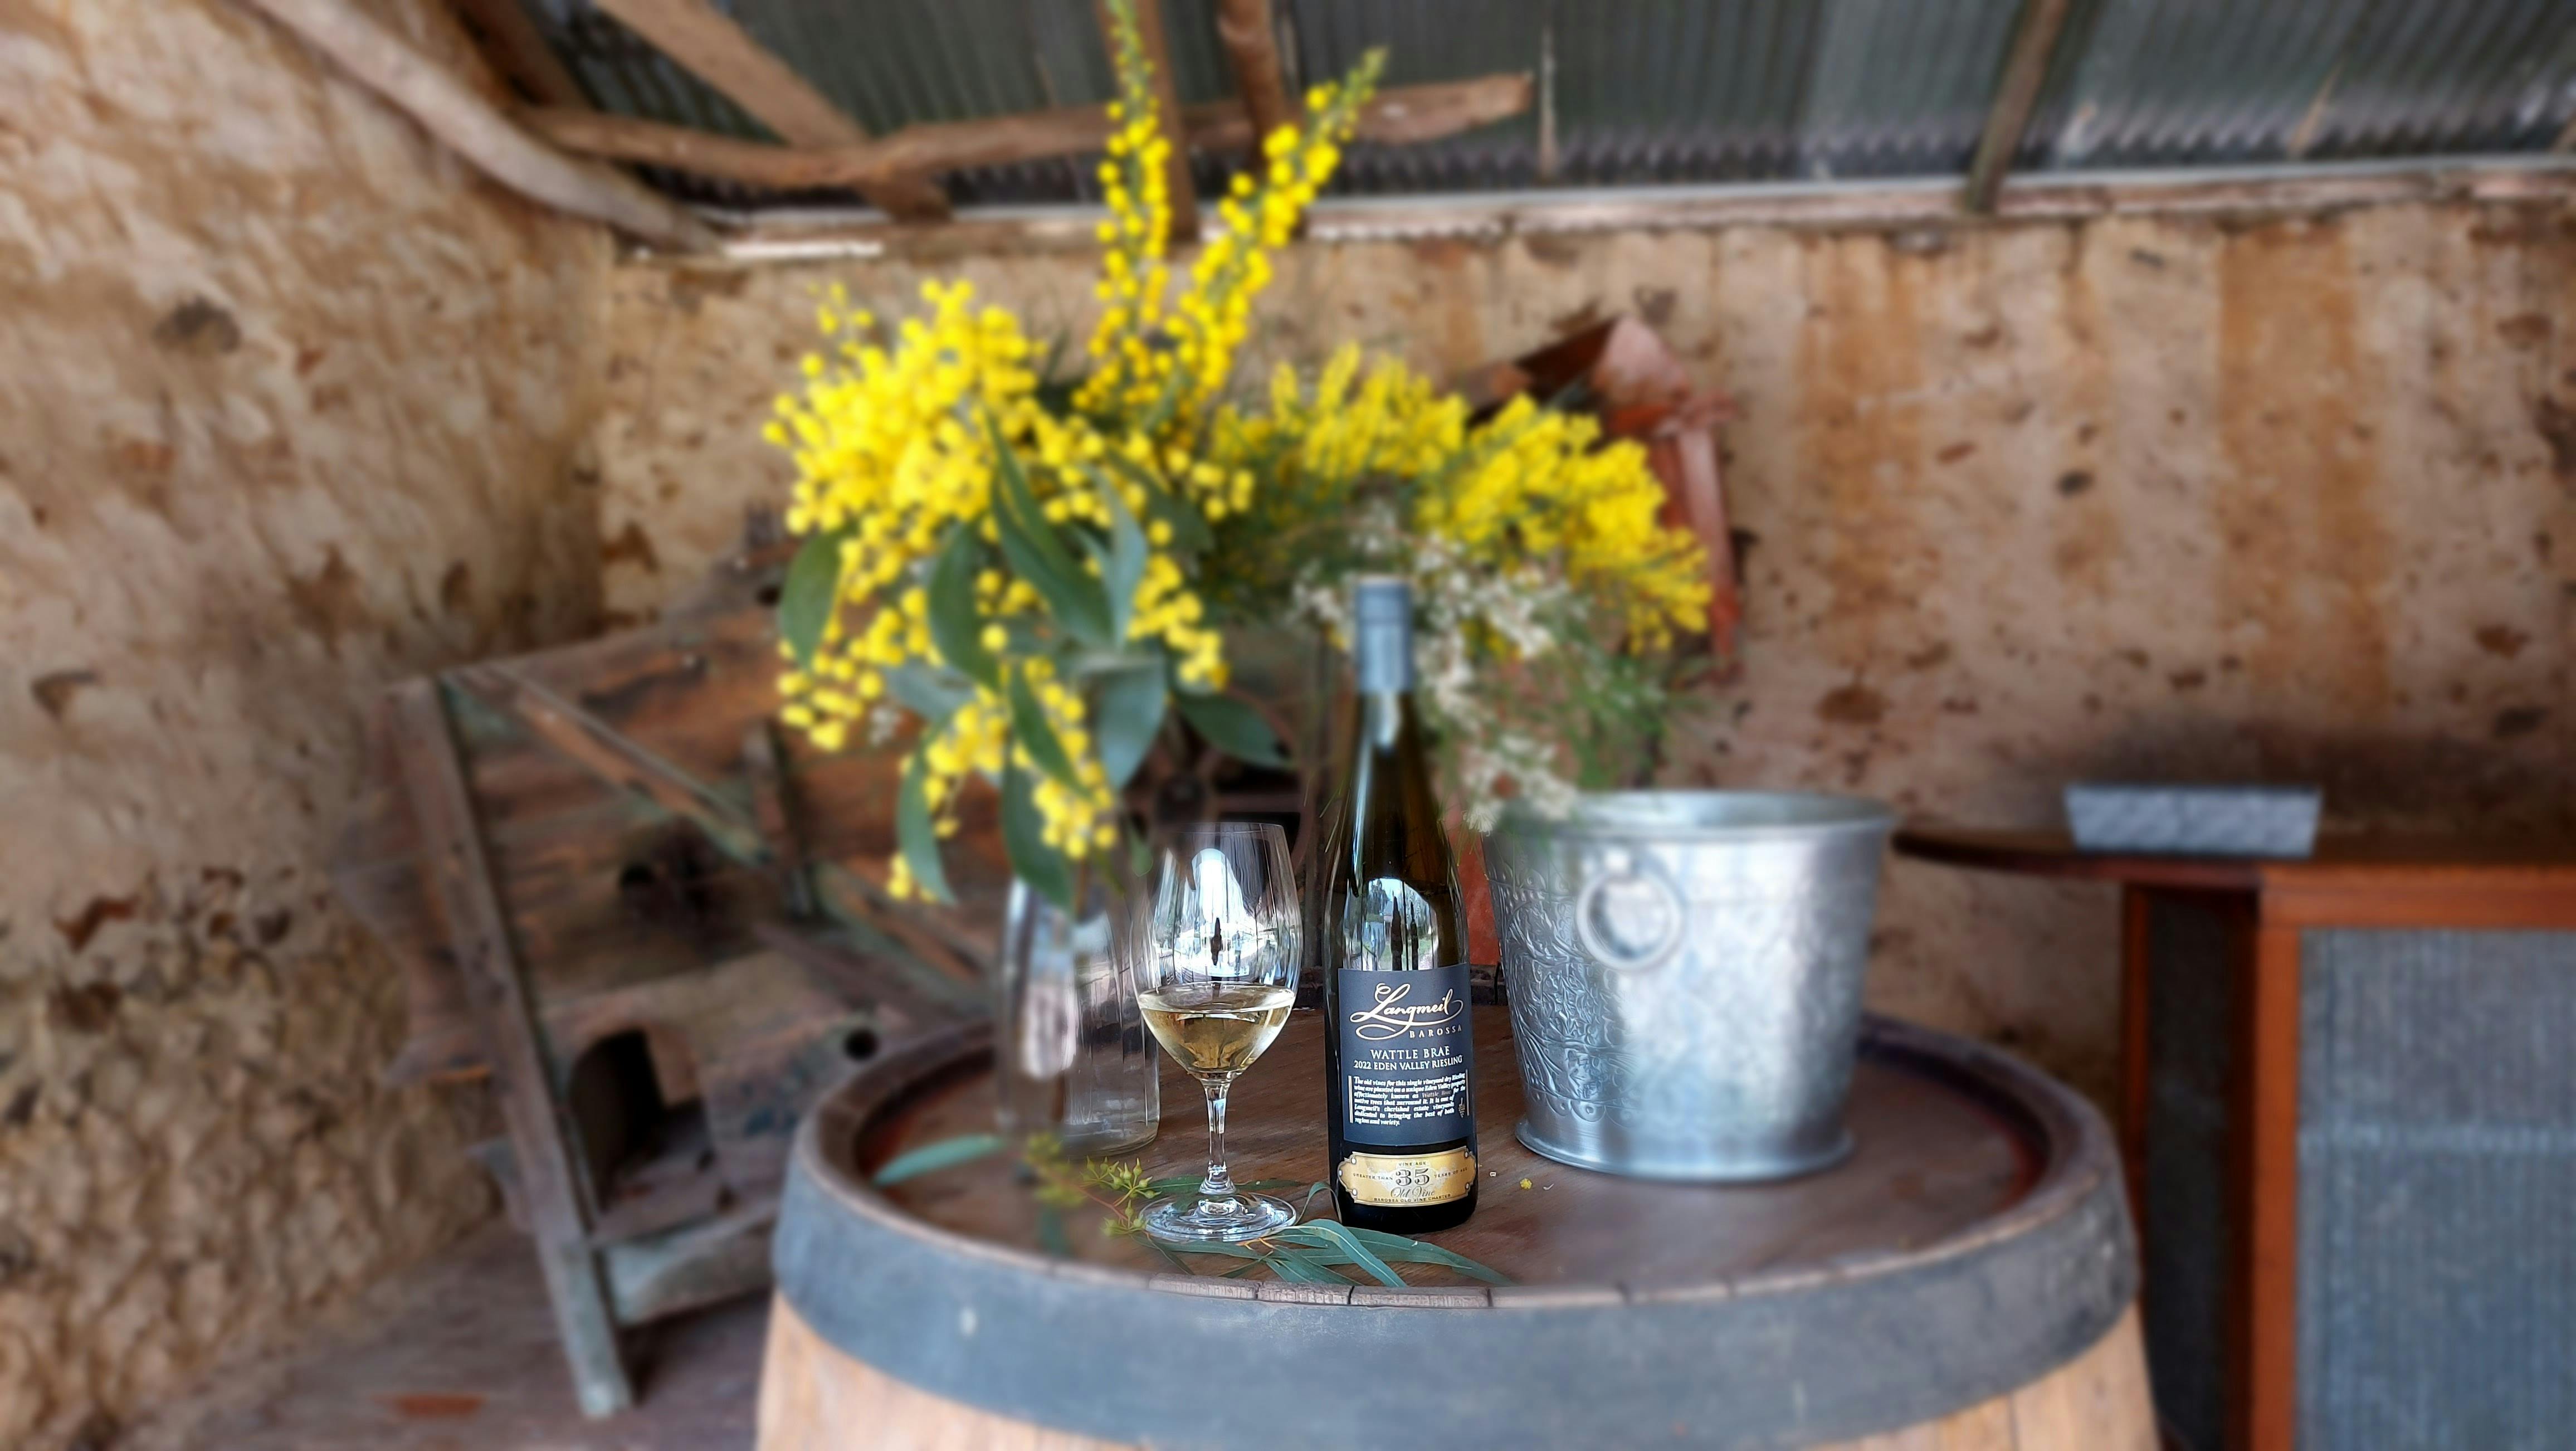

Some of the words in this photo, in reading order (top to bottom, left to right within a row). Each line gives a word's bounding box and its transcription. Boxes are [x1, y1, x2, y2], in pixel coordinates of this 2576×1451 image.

[1350, 983, 1463, 1040] Langmeil
[1409, 1024, 1462, 1038] BAROSSA
[1370, 1049, 1418, 1059] WATTLE
[1423, 1045, 1450, 1058] BRAE
[1354, 1060, 1372, 1069] 2022
[1374, 1062, 1397, 1070] EDEN
[1399, 1060, 1430, 1070] VALLEY
[1432, 1054, 1463, 1068] RIESLING
[1354, 1076, 1363, 1084] The
[1423, 1077, 1444, 1085] vineyard
[1396, 1168, 1430, 1186] 35
[1391, 1186, 1410, 1197] Old
[1412, 1185, 1435, 1197] Vine
